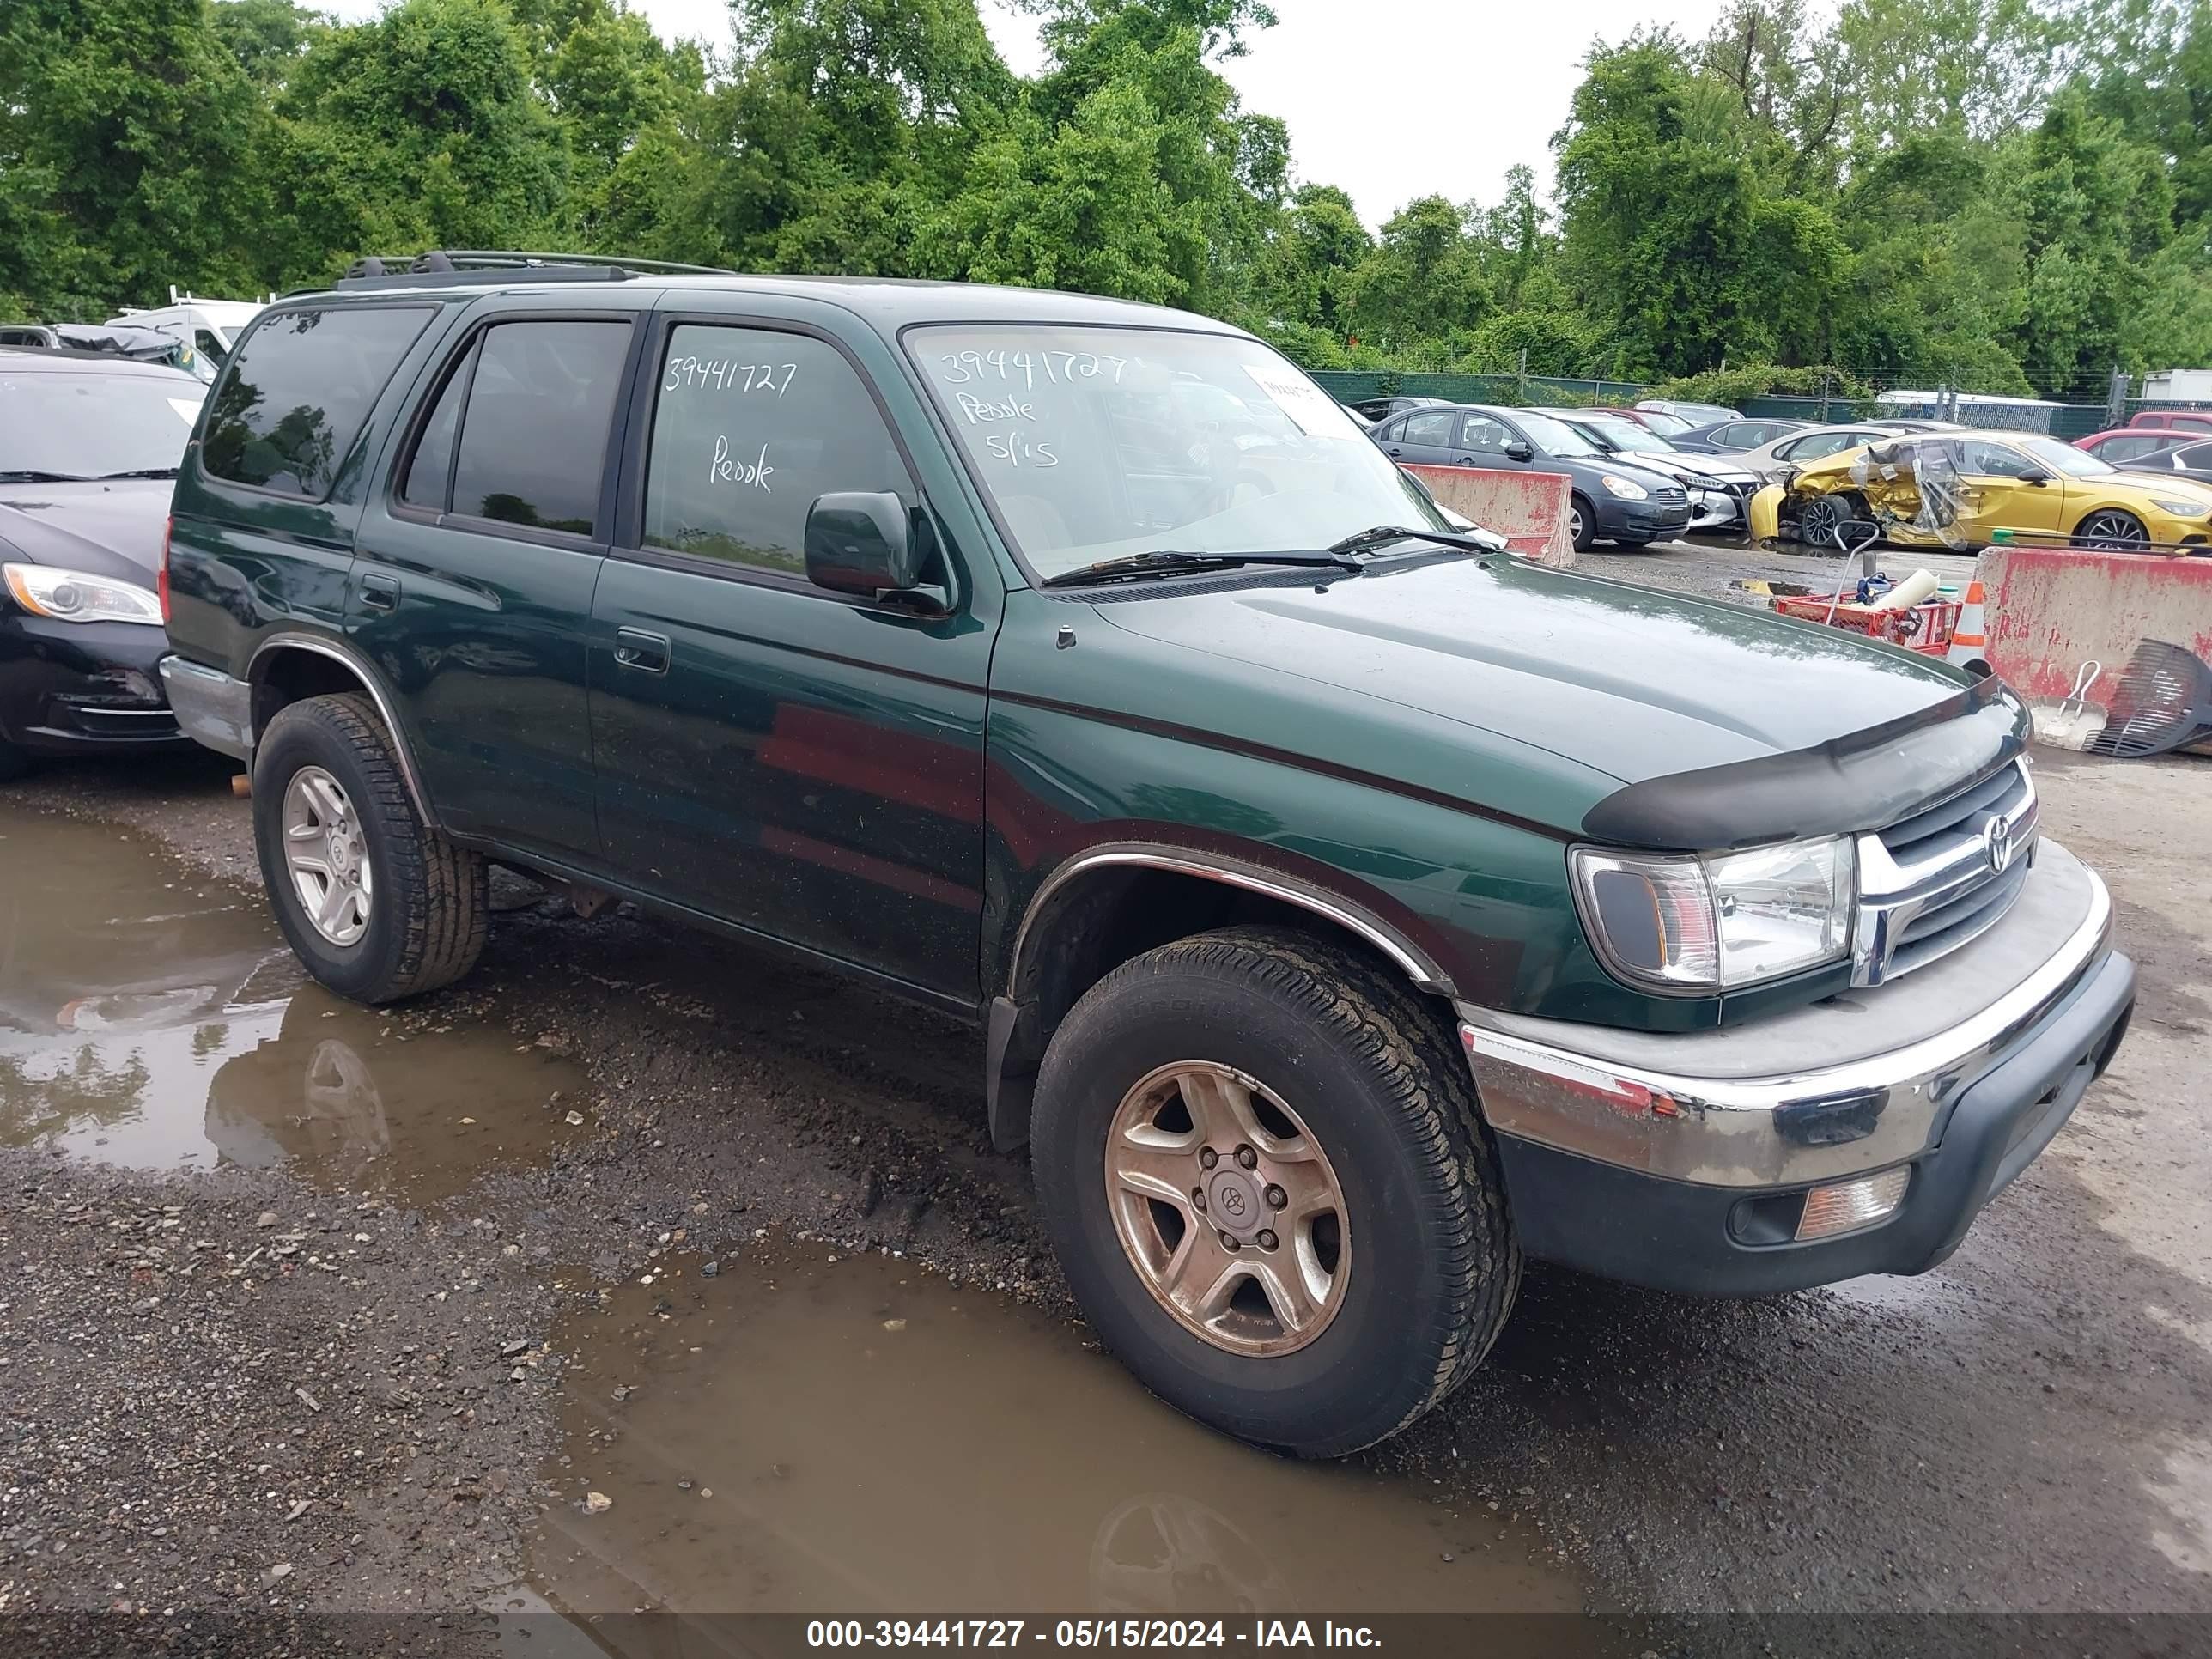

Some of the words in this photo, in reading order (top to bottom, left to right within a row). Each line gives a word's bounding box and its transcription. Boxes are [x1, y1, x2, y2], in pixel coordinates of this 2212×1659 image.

[665, 356, 797, 398] 39441727
[941, 349, 1127, 391] 39441727
[986, 431, 1059, 467] 5/15
